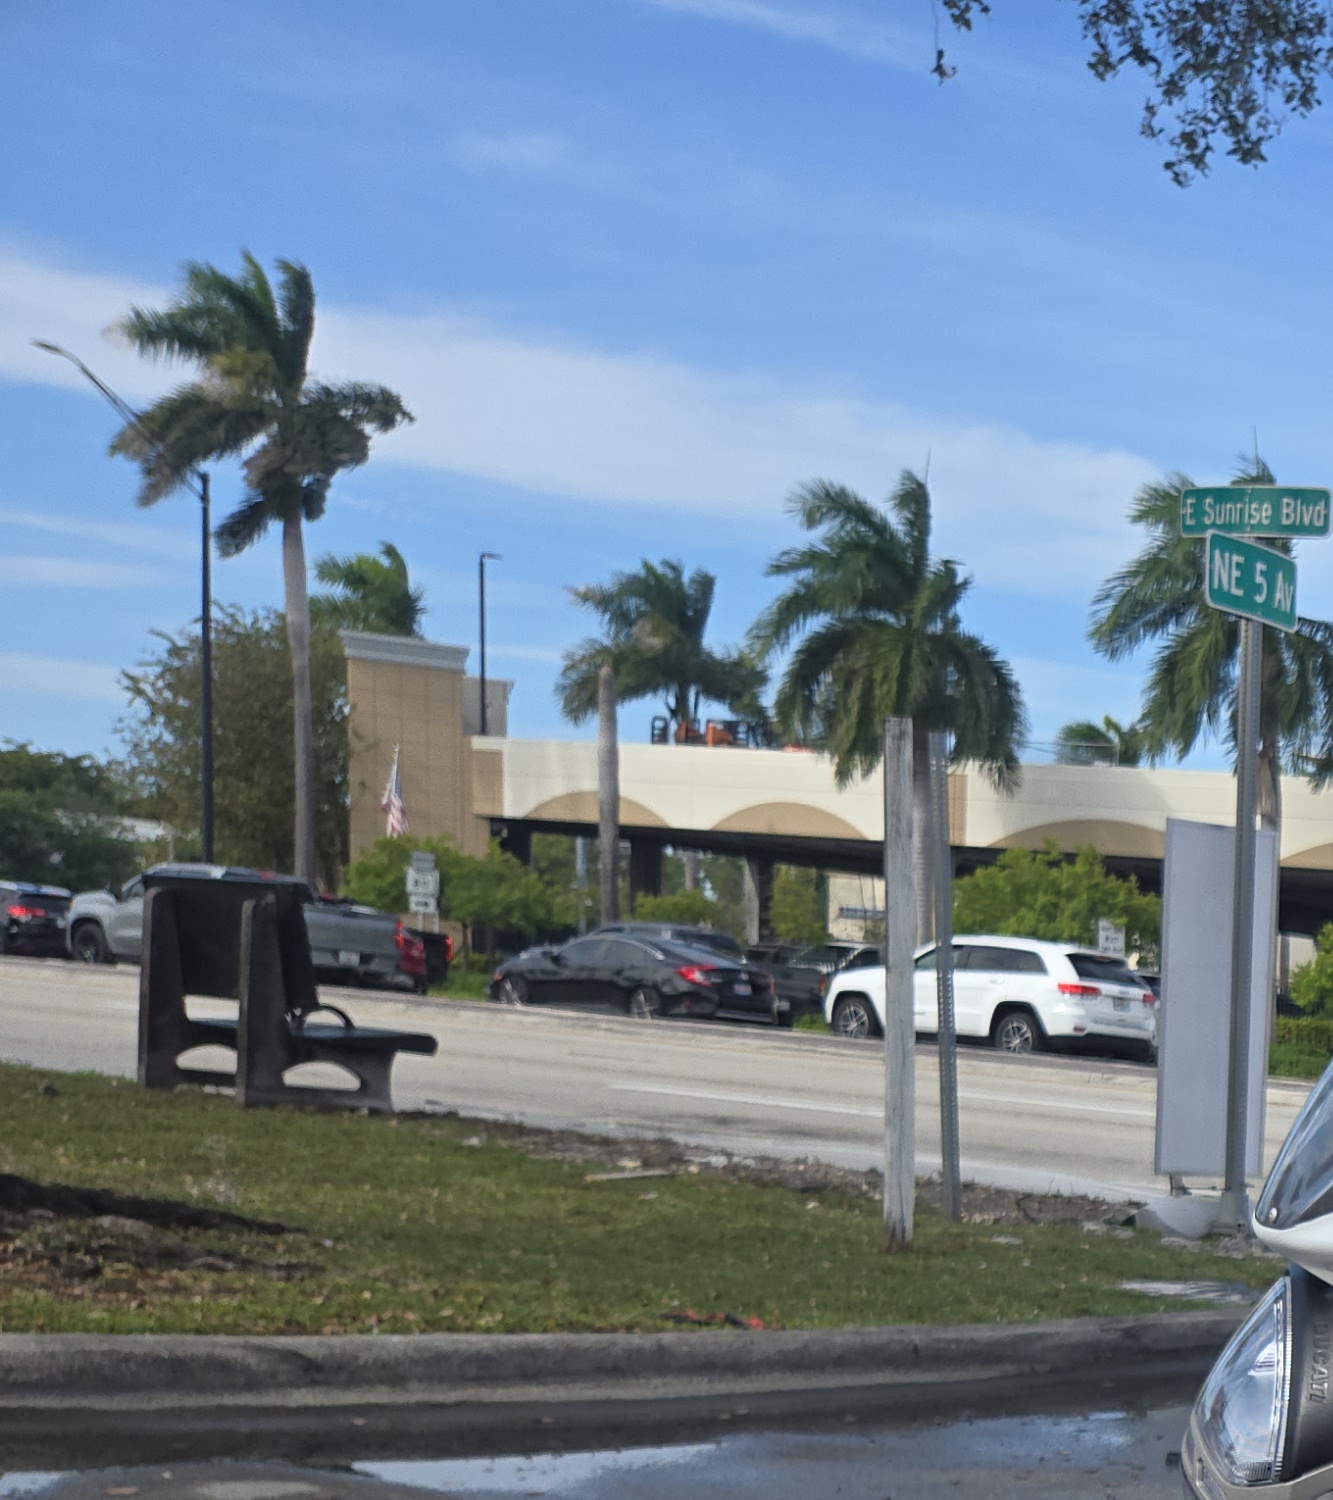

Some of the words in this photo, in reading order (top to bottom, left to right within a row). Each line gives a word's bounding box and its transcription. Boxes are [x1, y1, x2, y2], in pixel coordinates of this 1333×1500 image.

[1185, 497, 1196, 526] E
[1204, 496, 1272, 526] Sunrise
[1281, 497, 1325, 528] Blvd
[1212, 548, 1246, 597] NE
[1254, 561, 1268, 604] 5
[1310, 1321, 1331, 1405] DUCATI
